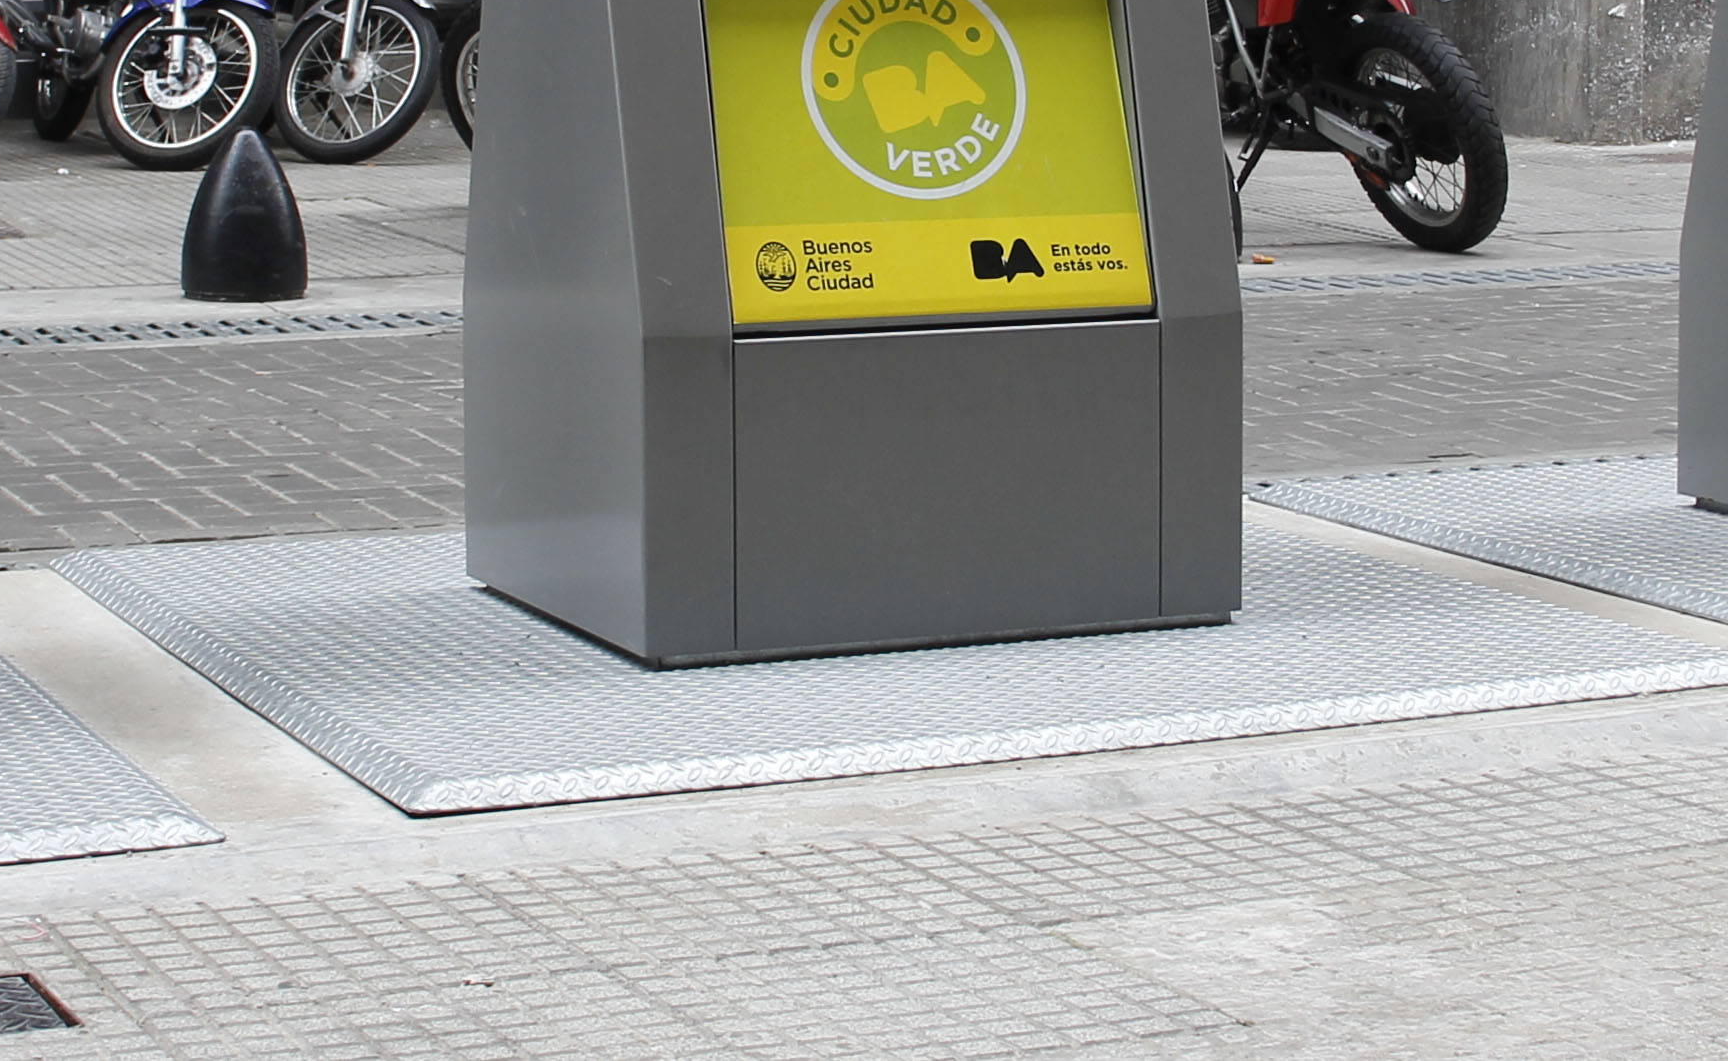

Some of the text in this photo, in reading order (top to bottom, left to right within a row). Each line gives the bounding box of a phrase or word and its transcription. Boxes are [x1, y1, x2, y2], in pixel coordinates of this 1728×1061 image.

[885, 113, 1000, 177] VERDE
[802, 239, 872, 255] Buenos
[1051, 243, 1111, 256] En todo
[805, 257, 852, 273] Aires
[1054, 258, 1128, 271] estás vos.
[806, 273, 874, 291] Ciudad
